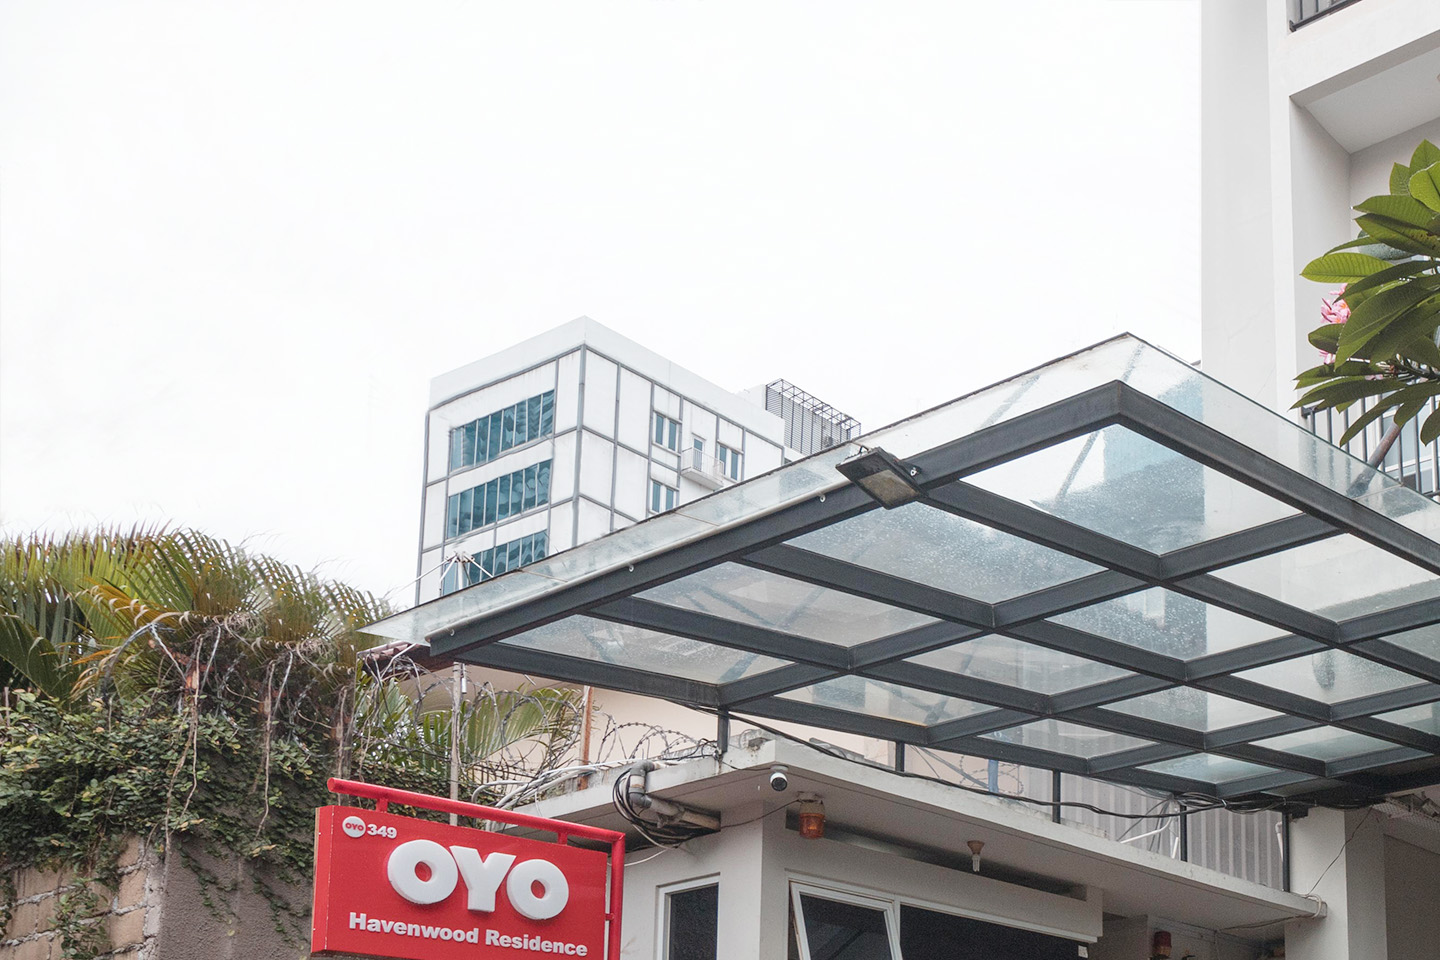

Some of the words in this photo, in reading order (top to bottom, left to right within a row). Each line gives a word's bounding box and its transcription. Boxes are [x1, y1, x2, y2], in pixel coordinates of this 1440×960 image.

[344, 822, 364, 831] OYO
[367, 823, 398, 839] 349
[387, 839, 570, 920] OYO
[349, 911, 479, 944] Havenwood
[485, 928, 588, 957] Residence
